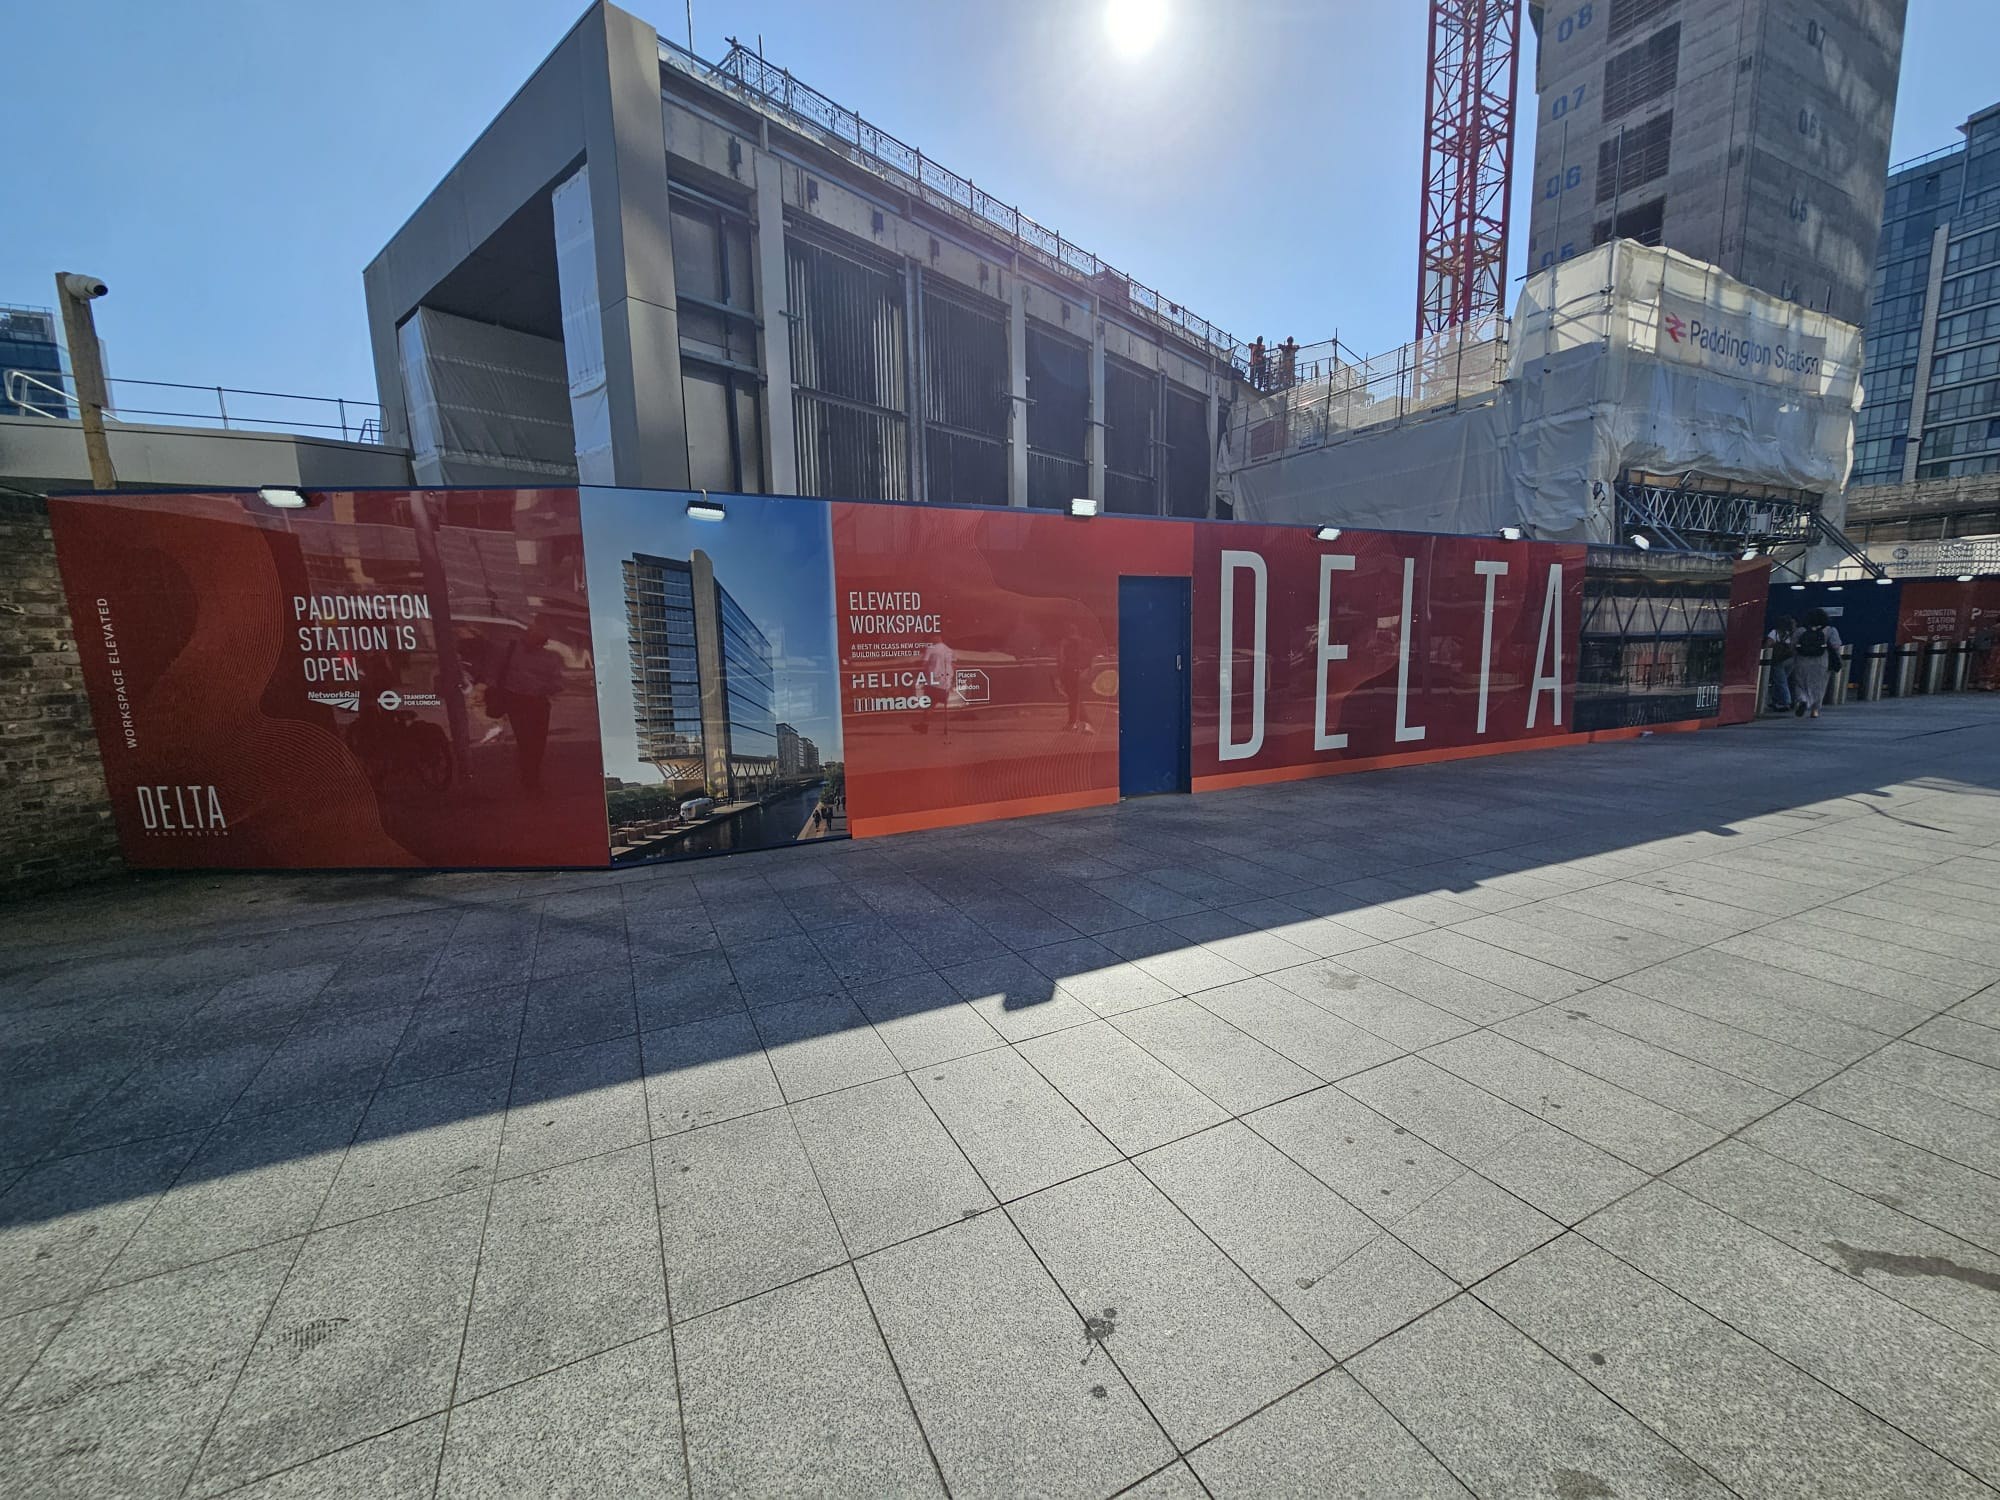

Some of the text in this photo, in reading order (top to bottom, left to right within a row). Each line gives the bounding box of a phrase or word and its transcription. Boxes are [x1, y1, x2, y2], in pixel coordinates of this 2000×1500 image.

[1558, 2, 1593, 43] 08
[1807, 19, 1827, 51] 07
[1551, 83, 1586, 120] 07
[1545, 164, 1582, 200] 06
[1690, 319, 1771, 366] Paddington
[294, 594, 430, 621] PADDINGTON
[850, 592, 921, 611] ELEVATED
[299, 625, 417, 651] STATION IS
[850, 615, 941, 634] WORKSPACE
[303, 657, 359, 682] OPEN
[1218, 550, 1563, 762] DELTA
[97, 598, 138, 749] WORKSPACE ELEVATED
[852, 671, 941, 689] HELICAL
[875, 695, 932, 711] mace
[1696, 685, 1719, 708] DELTA
[137, 785, 227, 829] DELTA
